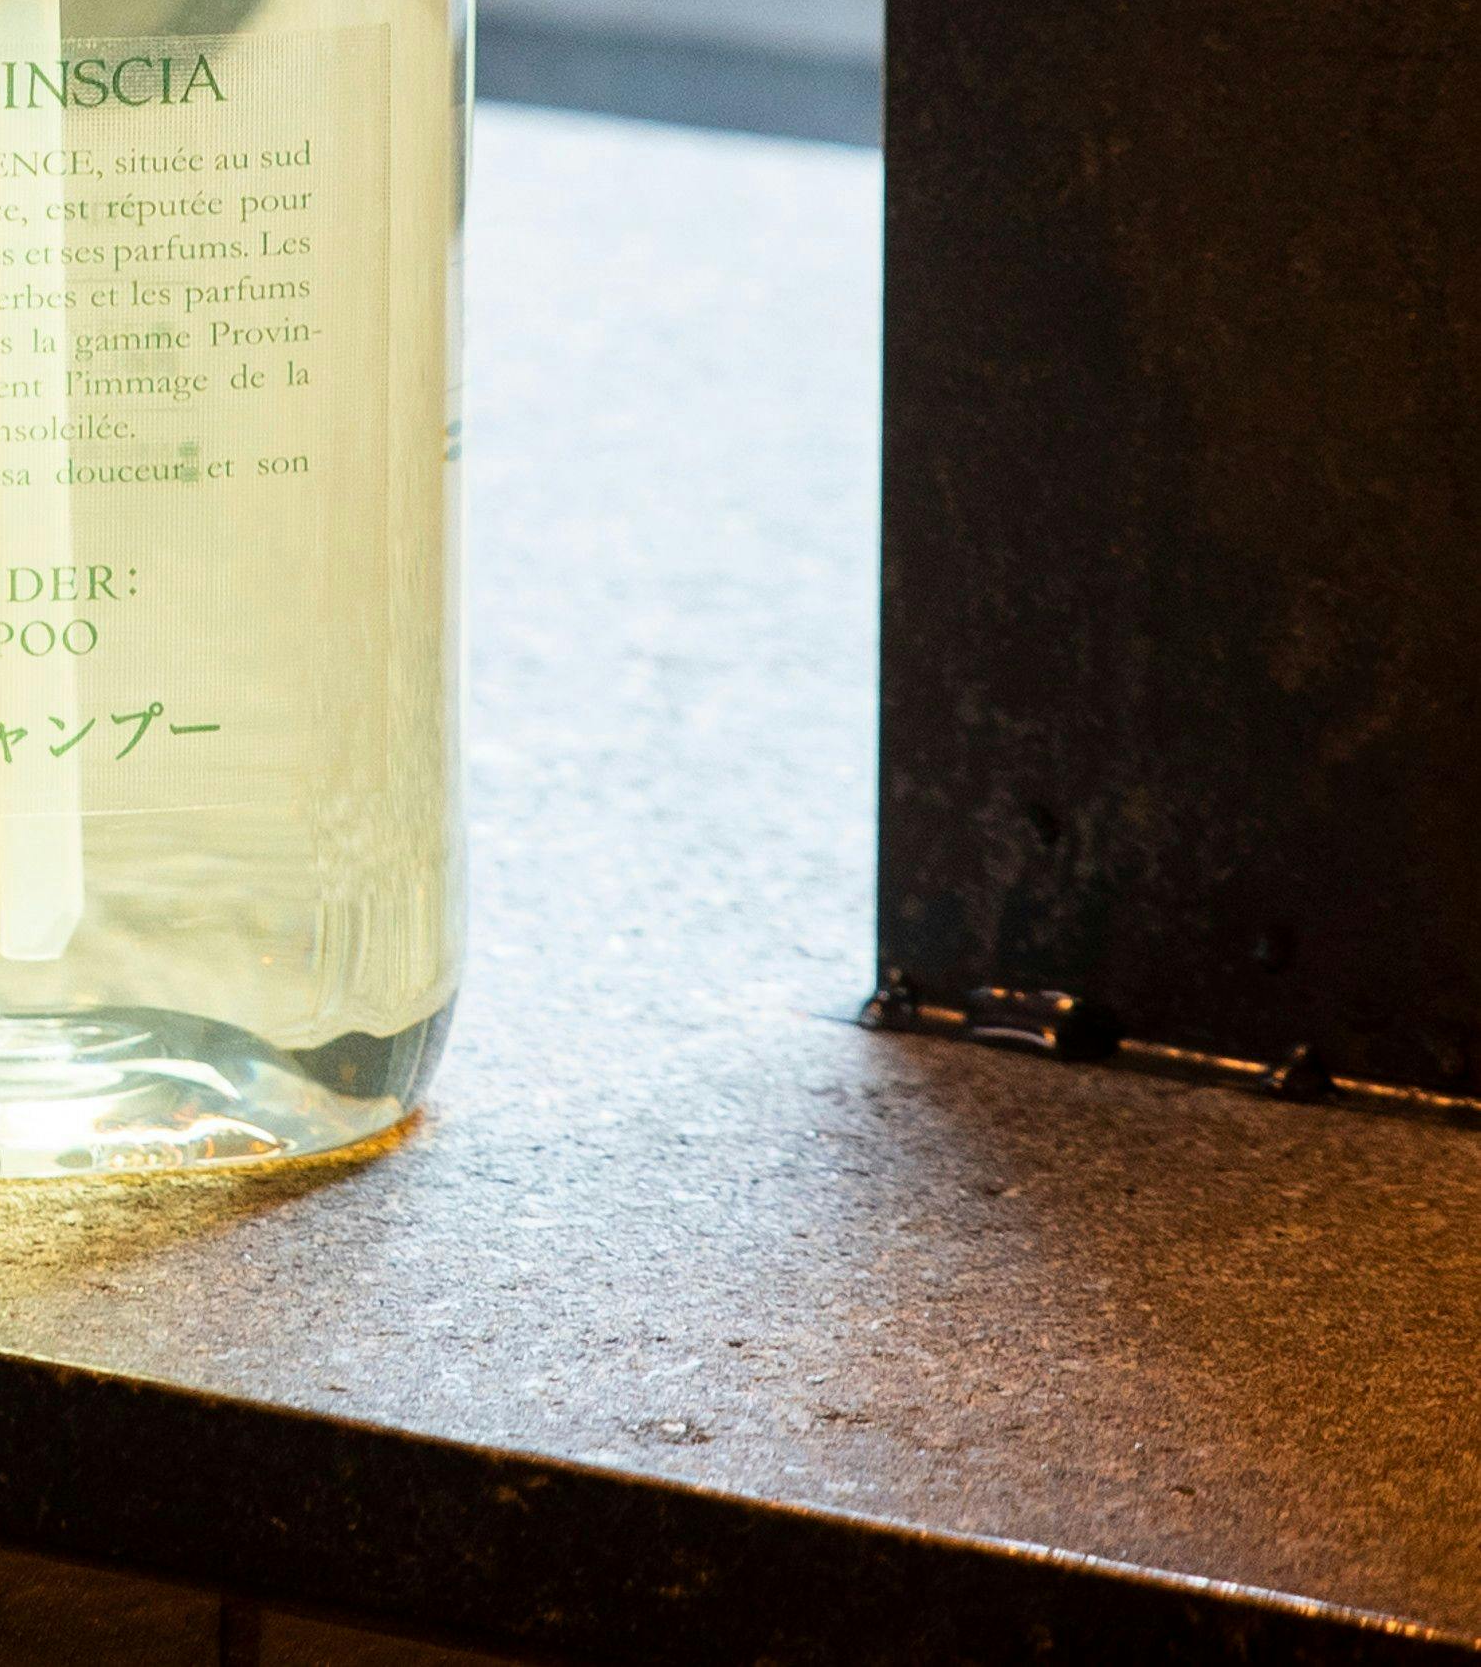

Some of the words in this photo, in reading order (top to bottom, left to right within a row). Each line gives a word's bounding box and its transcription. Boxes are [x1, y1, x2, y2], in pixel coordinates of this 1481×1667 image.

[116, 148, 204, 175] située
[214, 151, 248, 170] au
[260, 140, 311, 167] sud
[45, 199, 86, 220] est
[108, 191, 222, 226] réputée
[240, 191, 312, 220] pour
[25, 246, 51, 264] et
[59, 244, 105, 264] ses
[114, 236, 248, 271] parfums.
[260, 231, 311, 256] Les
[91, 284, 120, 306] et
[132, 280, 172, 305] les
[185, 277, 311, 311] parfums
[33, 329, 57, 353] la
[75, 328, 191, 360] gamme
[208, 317, 321, 346] Provin-
[66, 369, 208, 403] l'immage
[230, 362, 265, 389] de
[287, 361, 310, 386] la
[2, 467, 31, 486] sa
[56, 459, 183, 484] douceur
[207, 458, 234, 477] et
[257, 453, 309, 475] son
